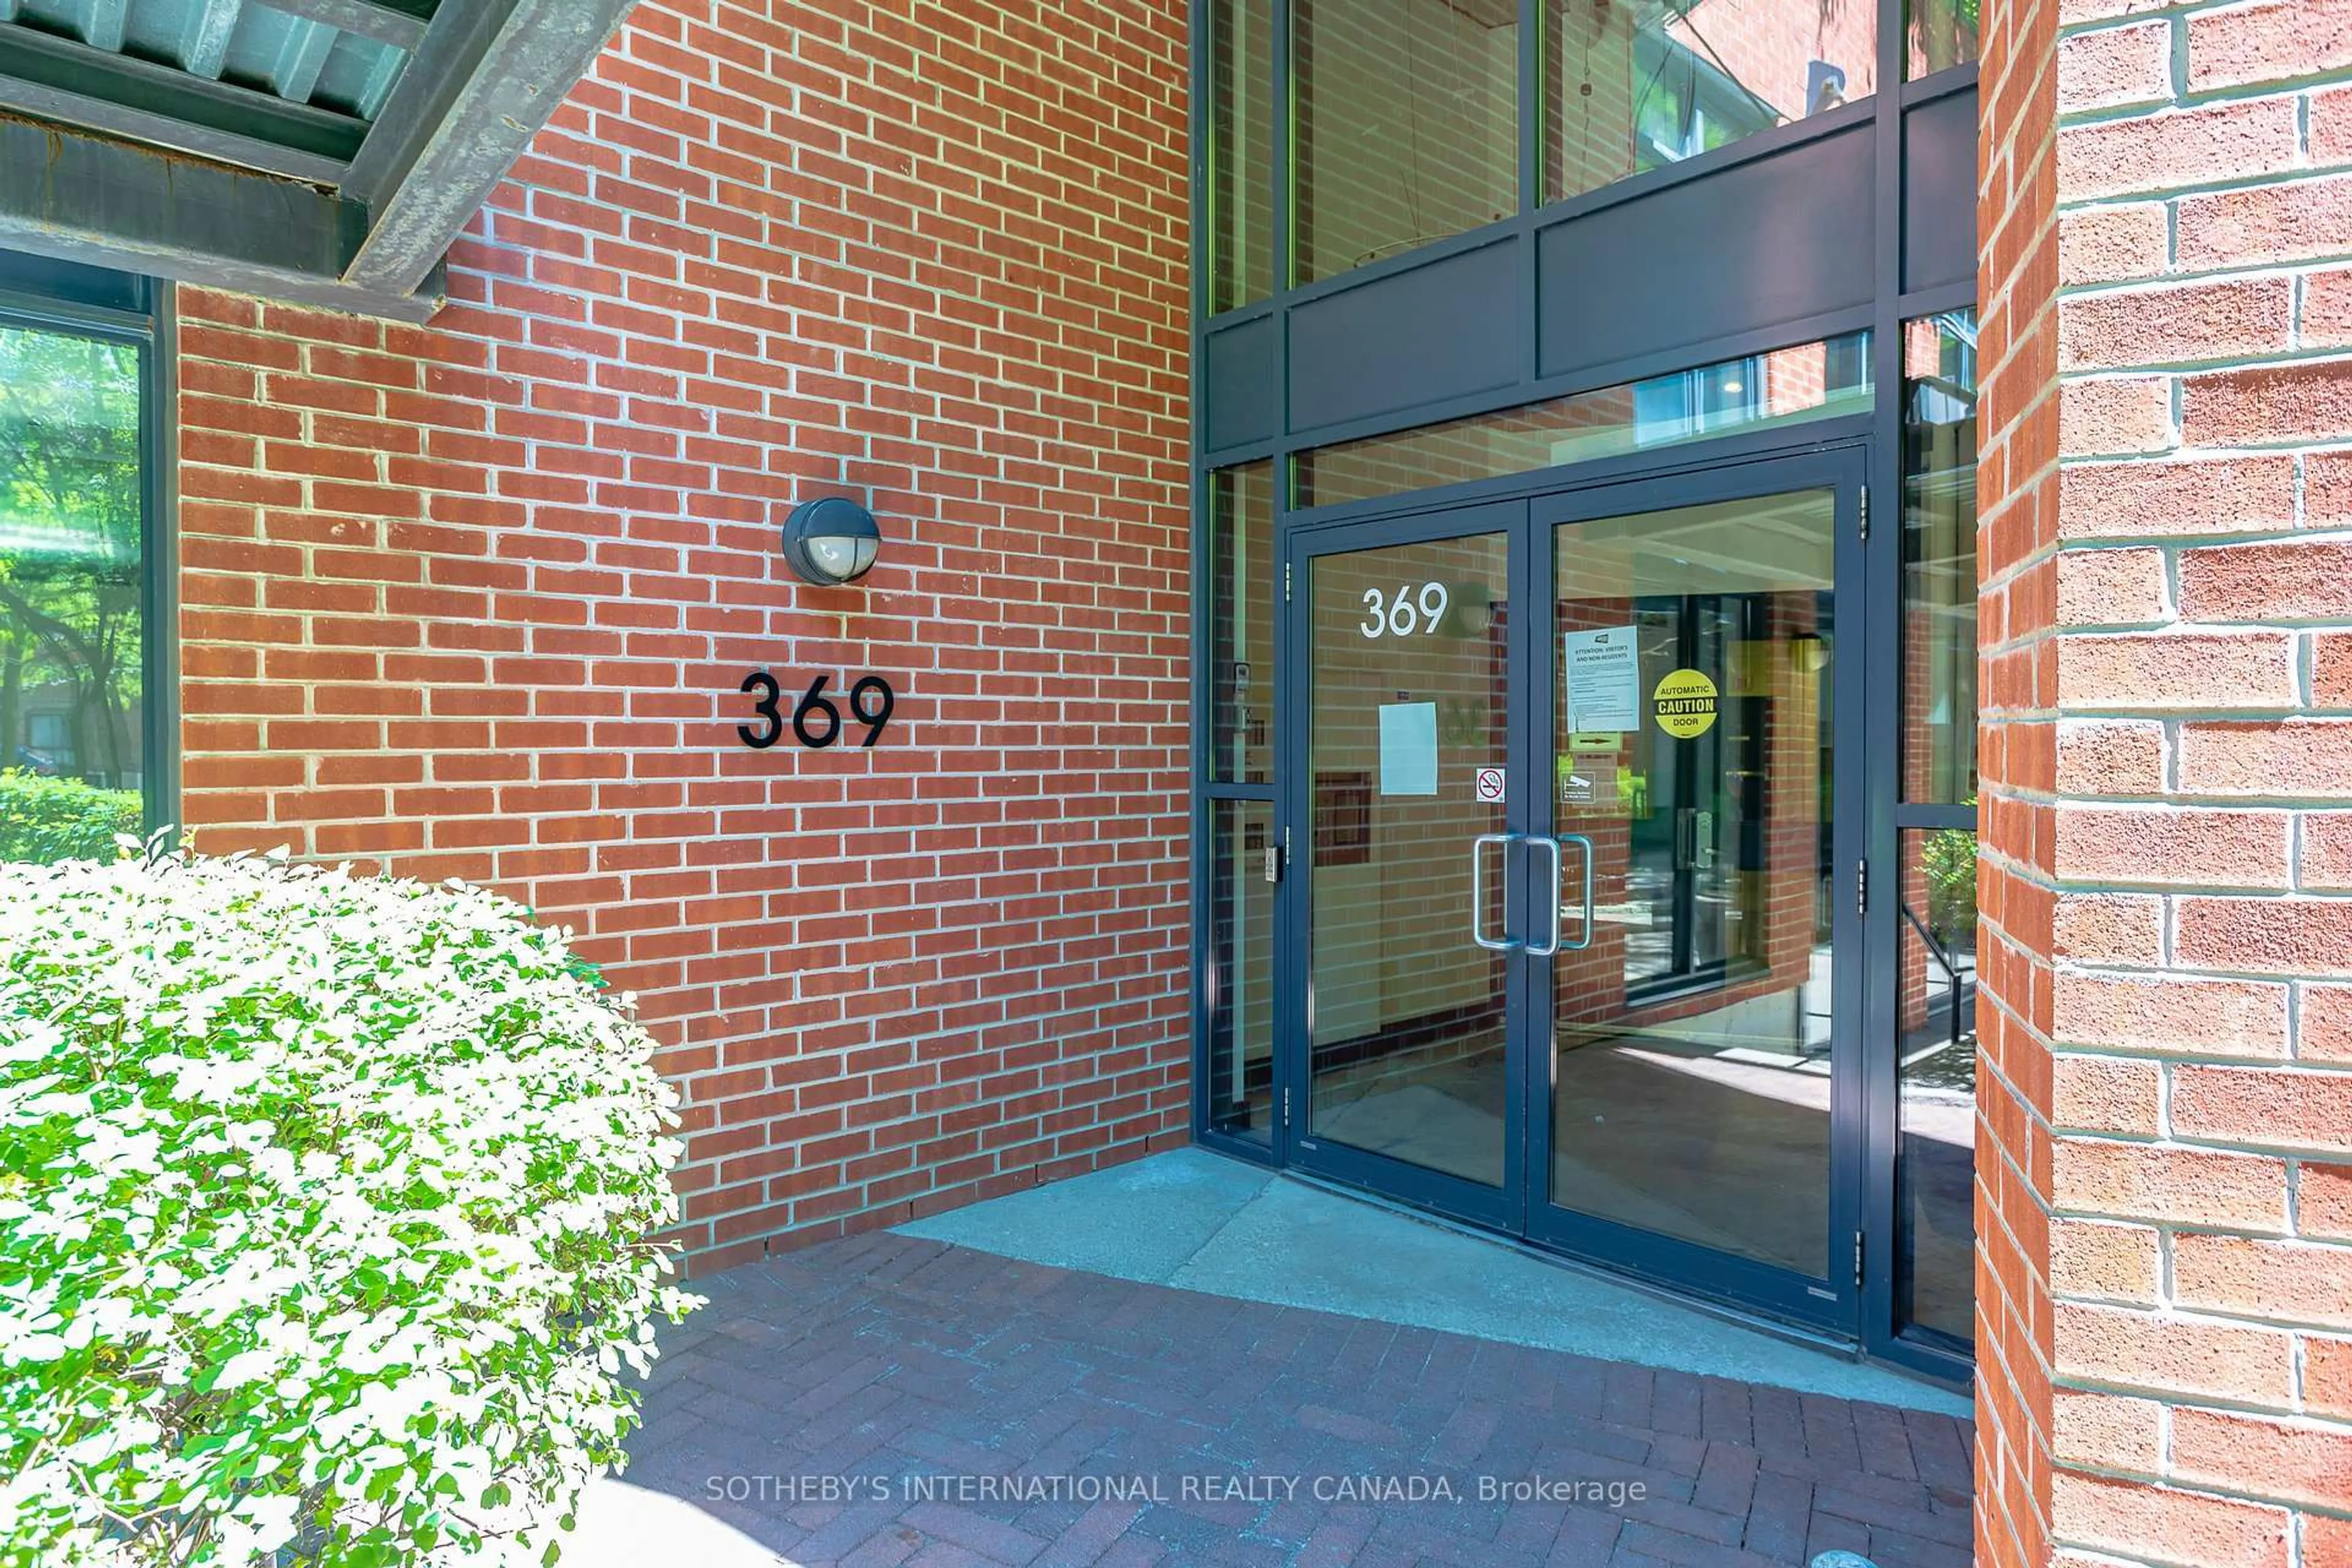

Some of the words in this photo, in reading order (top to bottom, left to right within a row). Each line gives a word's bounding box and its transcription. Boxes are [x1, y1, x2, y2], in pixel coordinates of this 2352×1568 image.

[1360, 581, 1448, 638] 369
[1658, 698, 1714, 714] CAUTION
[1660, 685, 1710, 695] AUTOMATIC
[737, 672, 894, 748] 369
